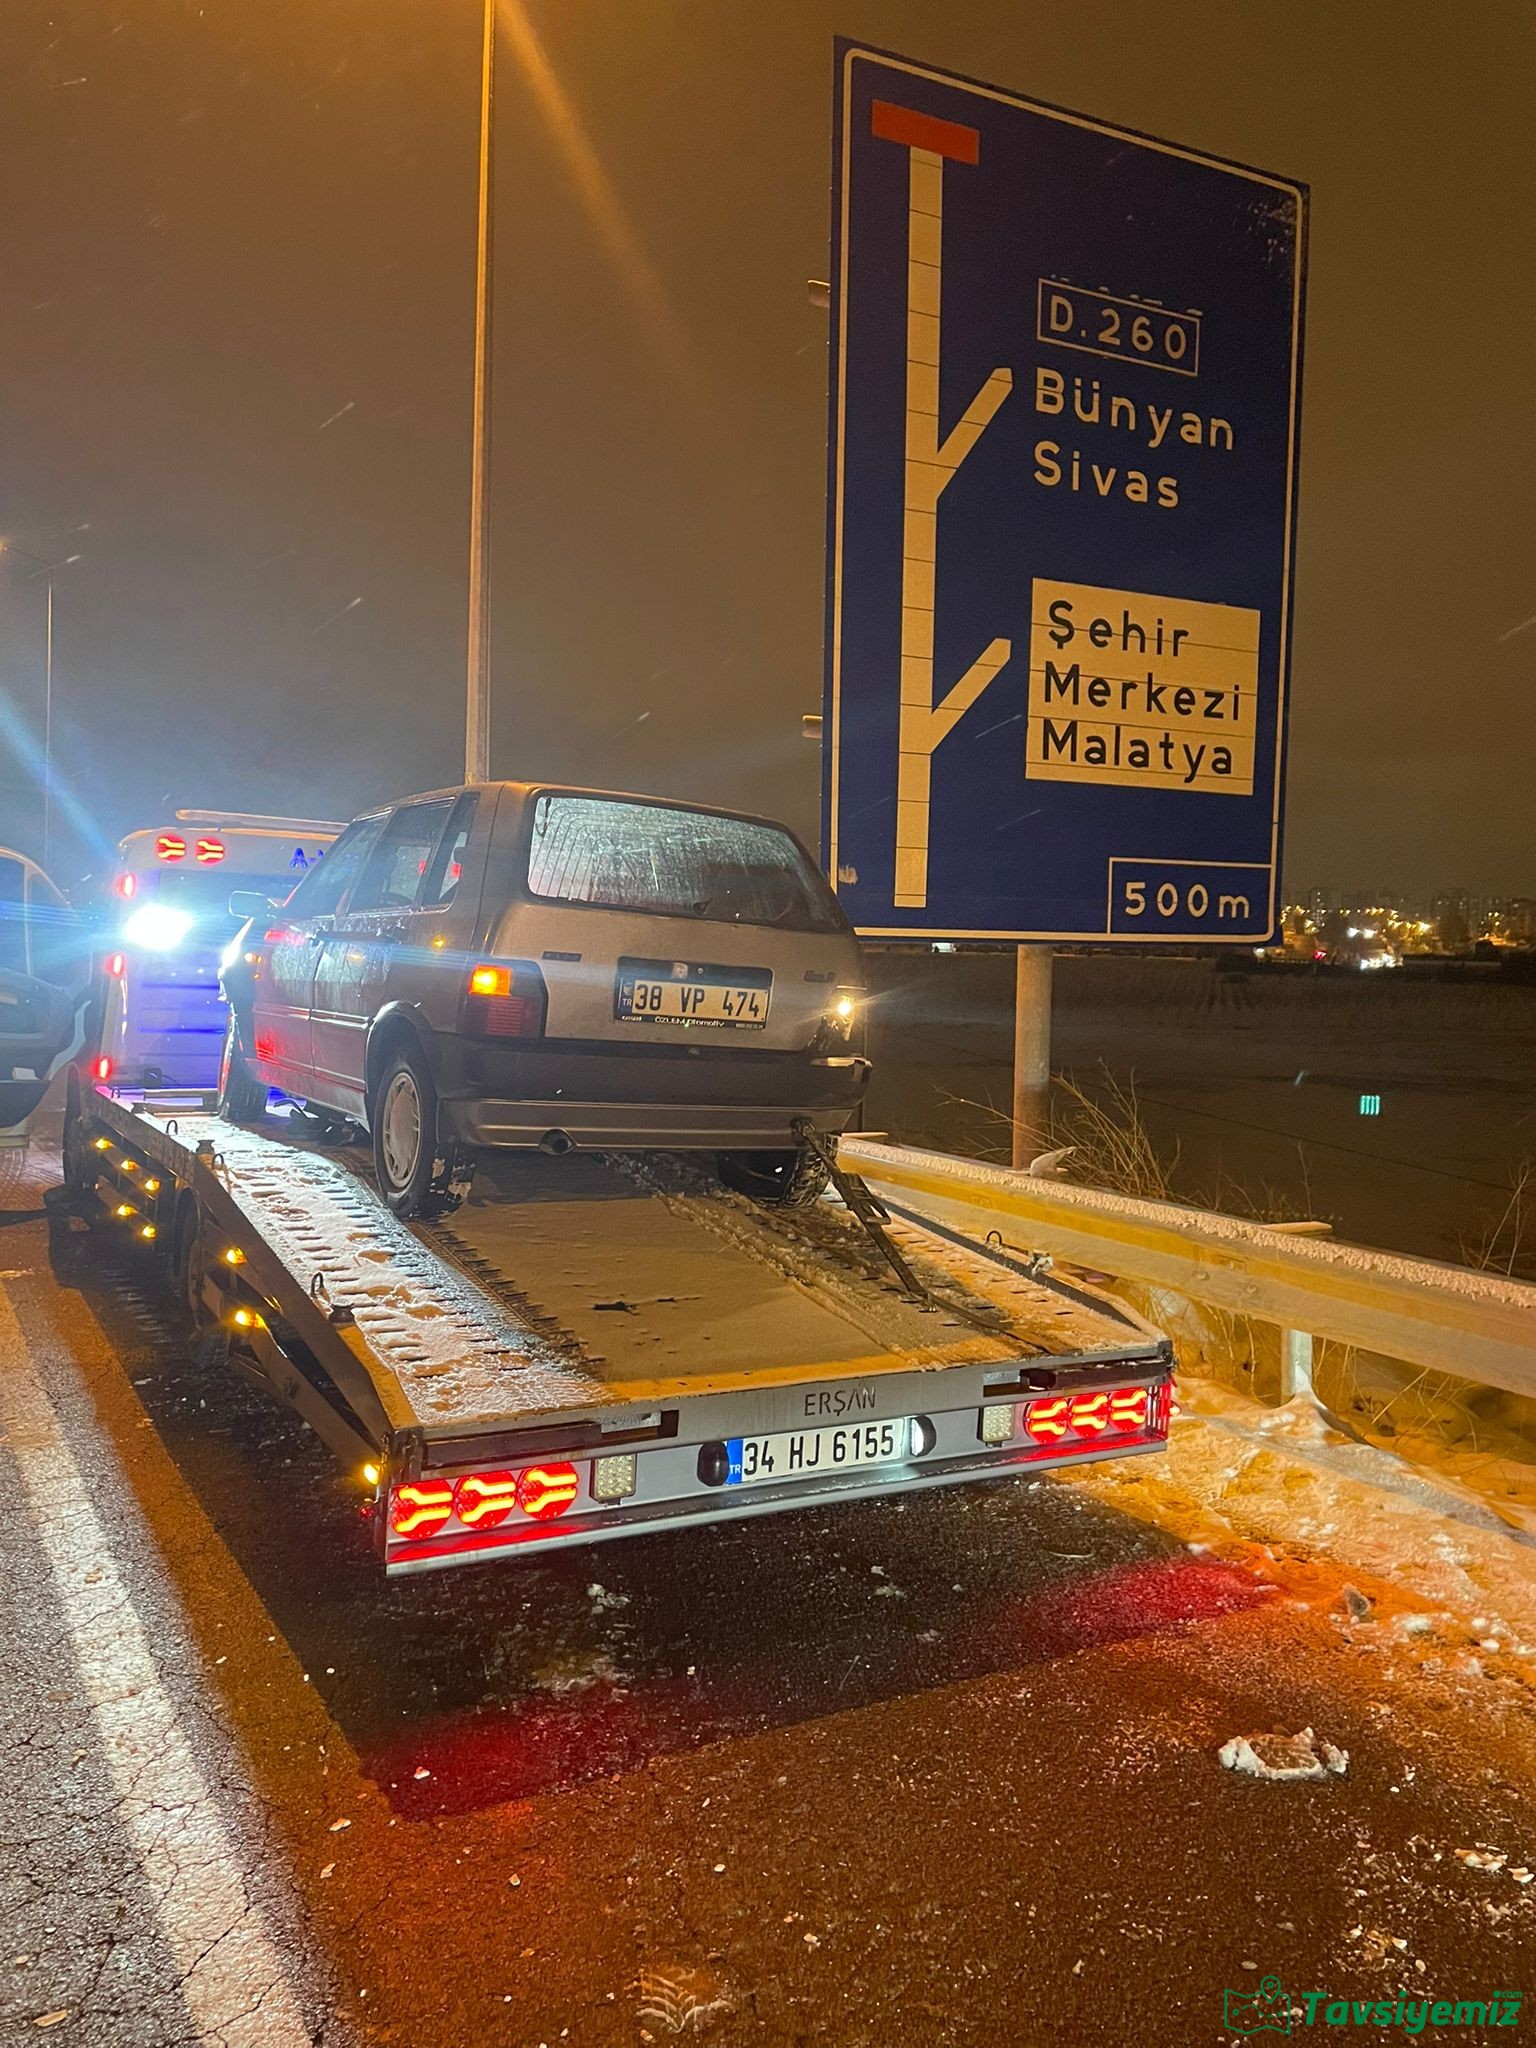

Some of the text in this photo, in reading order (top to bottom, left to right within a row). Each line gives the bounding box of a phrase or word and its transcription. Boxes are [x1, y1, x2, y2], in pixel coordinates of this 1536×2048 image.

[1050, 294, 1187, 359] D.260
[1035, 366, 1234, 450] Bünyan
[1033, 440, 1179, 508] Sivas
[1048, 599, 1189, 657] Şehir
[1044, 660, 1240, 720] Merkezi
[1042, 718, 1232, 783] Malatya
[1124, 881, 1250, 919] 500 m
[634, 984, 663, 1011] 38
[680, 986, 706, 1014] VP
[722, 990, 760, 1018] 474
[804, 1386, 877, 1416] ERŞAN
[729, 1424, 894, 1475] TR 34 HJ 6155
